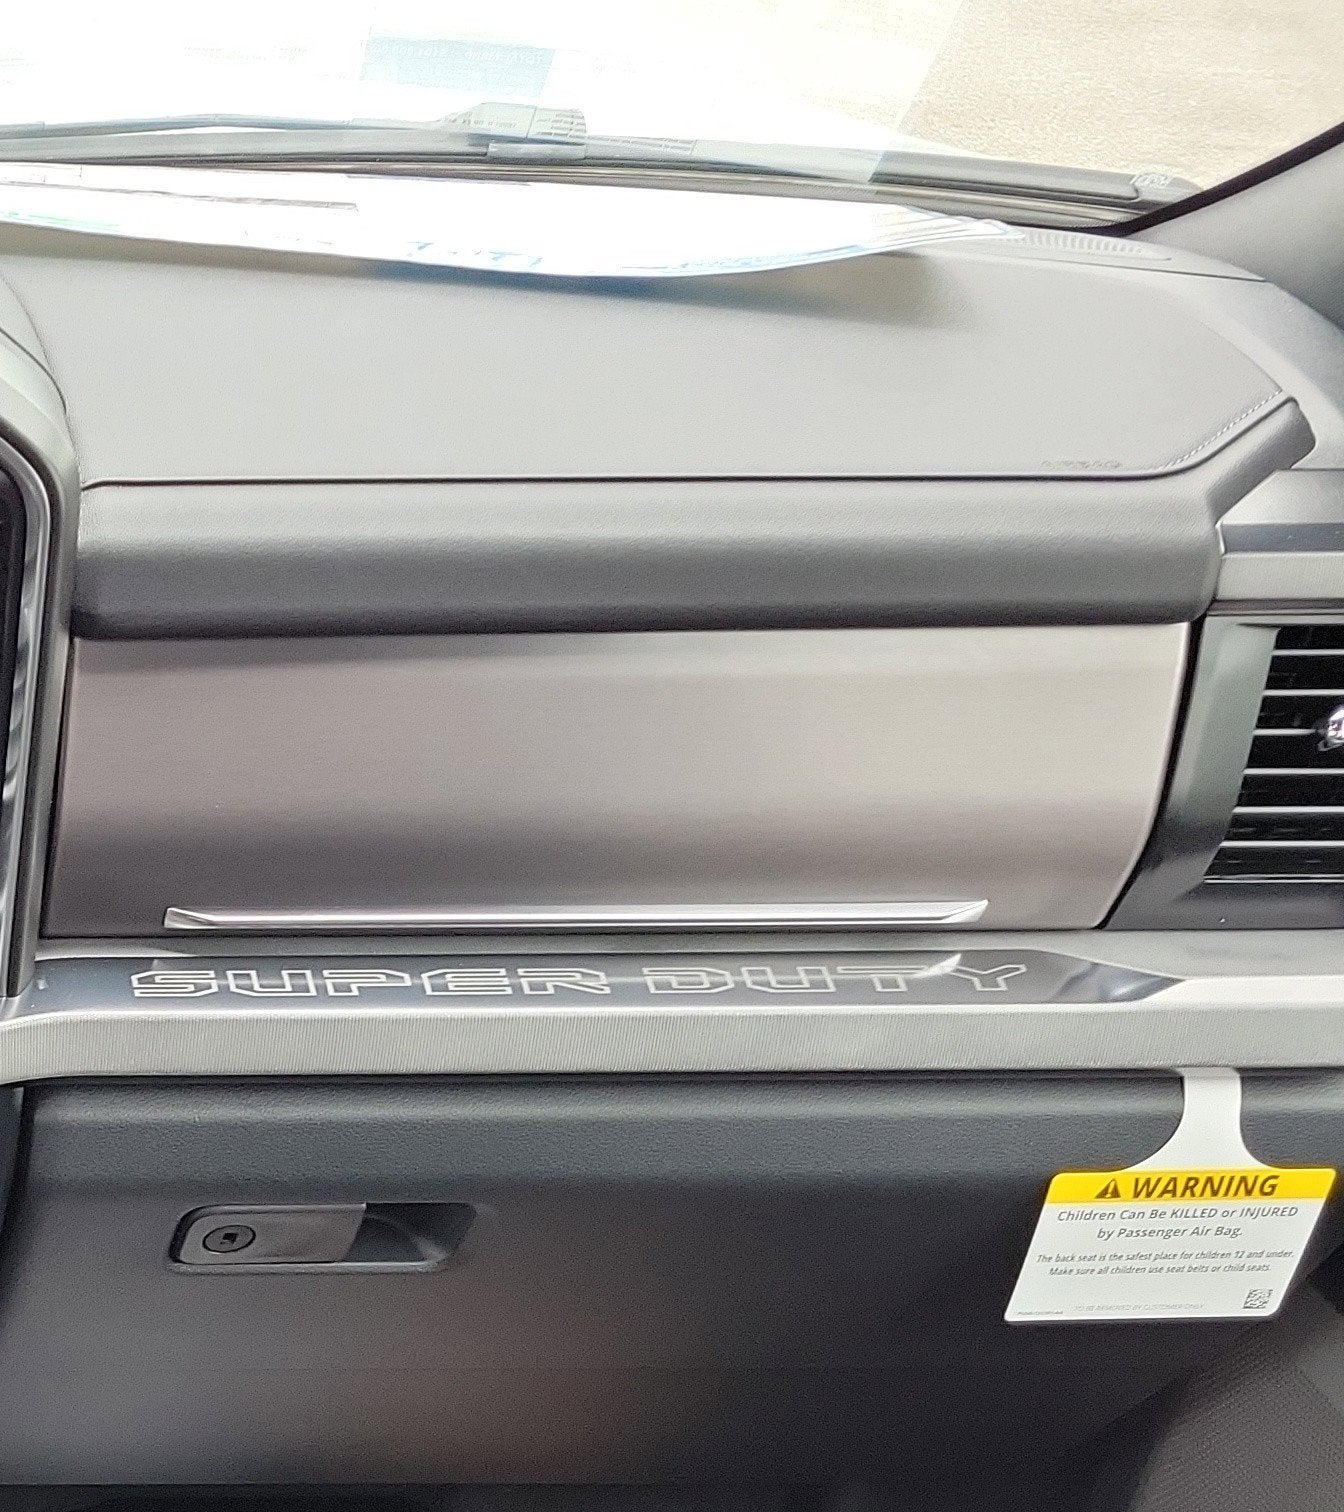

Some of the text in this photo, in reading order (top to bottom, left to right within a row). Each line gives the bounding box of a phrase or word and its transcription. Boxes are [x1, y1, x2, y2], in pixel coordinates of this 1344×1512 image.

[129, 962, 1029, 998] SUPER DUTY
[1131, 1173, 1281, 1199] WARNING
[1057, 1205, 1299, 1222] Children Can Be KILLED or INJURED
[1096, 1225, 1244, 1240] by Passenger Air Bag.
[1037, 1254, 1053, 1263] The
[1054, 1254, 1075, 1263] back
[1077, 1254, 1098, 1262] seat
[1099, 1254, 1107, 1262] is
[1108, 1253, 1124, 1261] the
[1124, 1252, 1152, 1261] safest
[1152, 1252, 1178, 1262] place
[1179, 1252, 1193, 1260] for
[1195, 1250, 1232, 1259] children
[1233, 1250, 1244, 1259] 12
[1246, 1250, 1264, 1258] and
[1049, 1267, 1074, 1276] Make
[1075, 1268, 1095, 1276] sure
[1097, 1266, 1110, 1275] all
[1110, 1265, 1148, 1274] children
[1165, 1265, 1186, 1274] seat
[1187, 1264, 1209, 1273] belts
[1223, 1264, 1245, 1273] child
